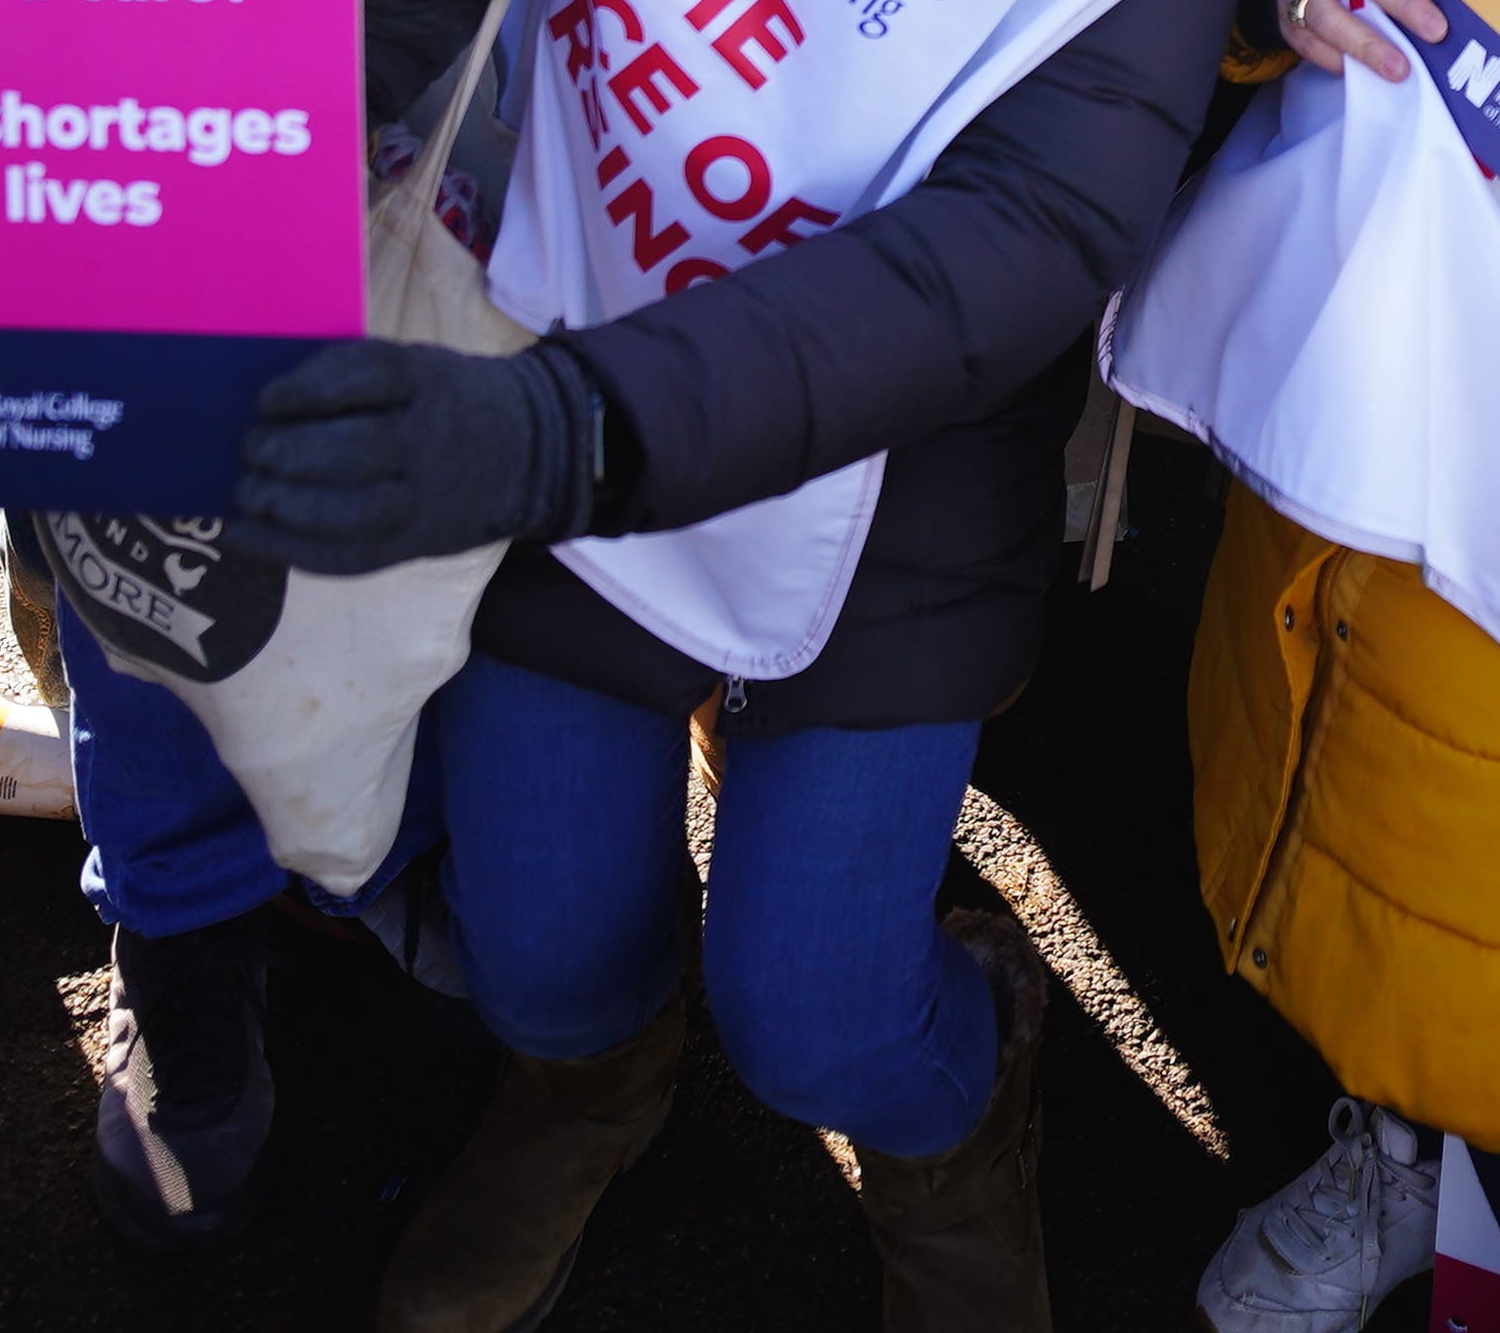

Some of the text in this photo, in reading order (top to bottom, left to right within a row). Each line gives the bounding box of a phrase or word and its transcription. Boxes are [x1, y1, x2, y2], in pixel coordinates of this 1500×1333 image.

[5, 160, 163, 227] lives
[44, 391, 124, 431] College
[9, 422, 94, 461] Nursing
